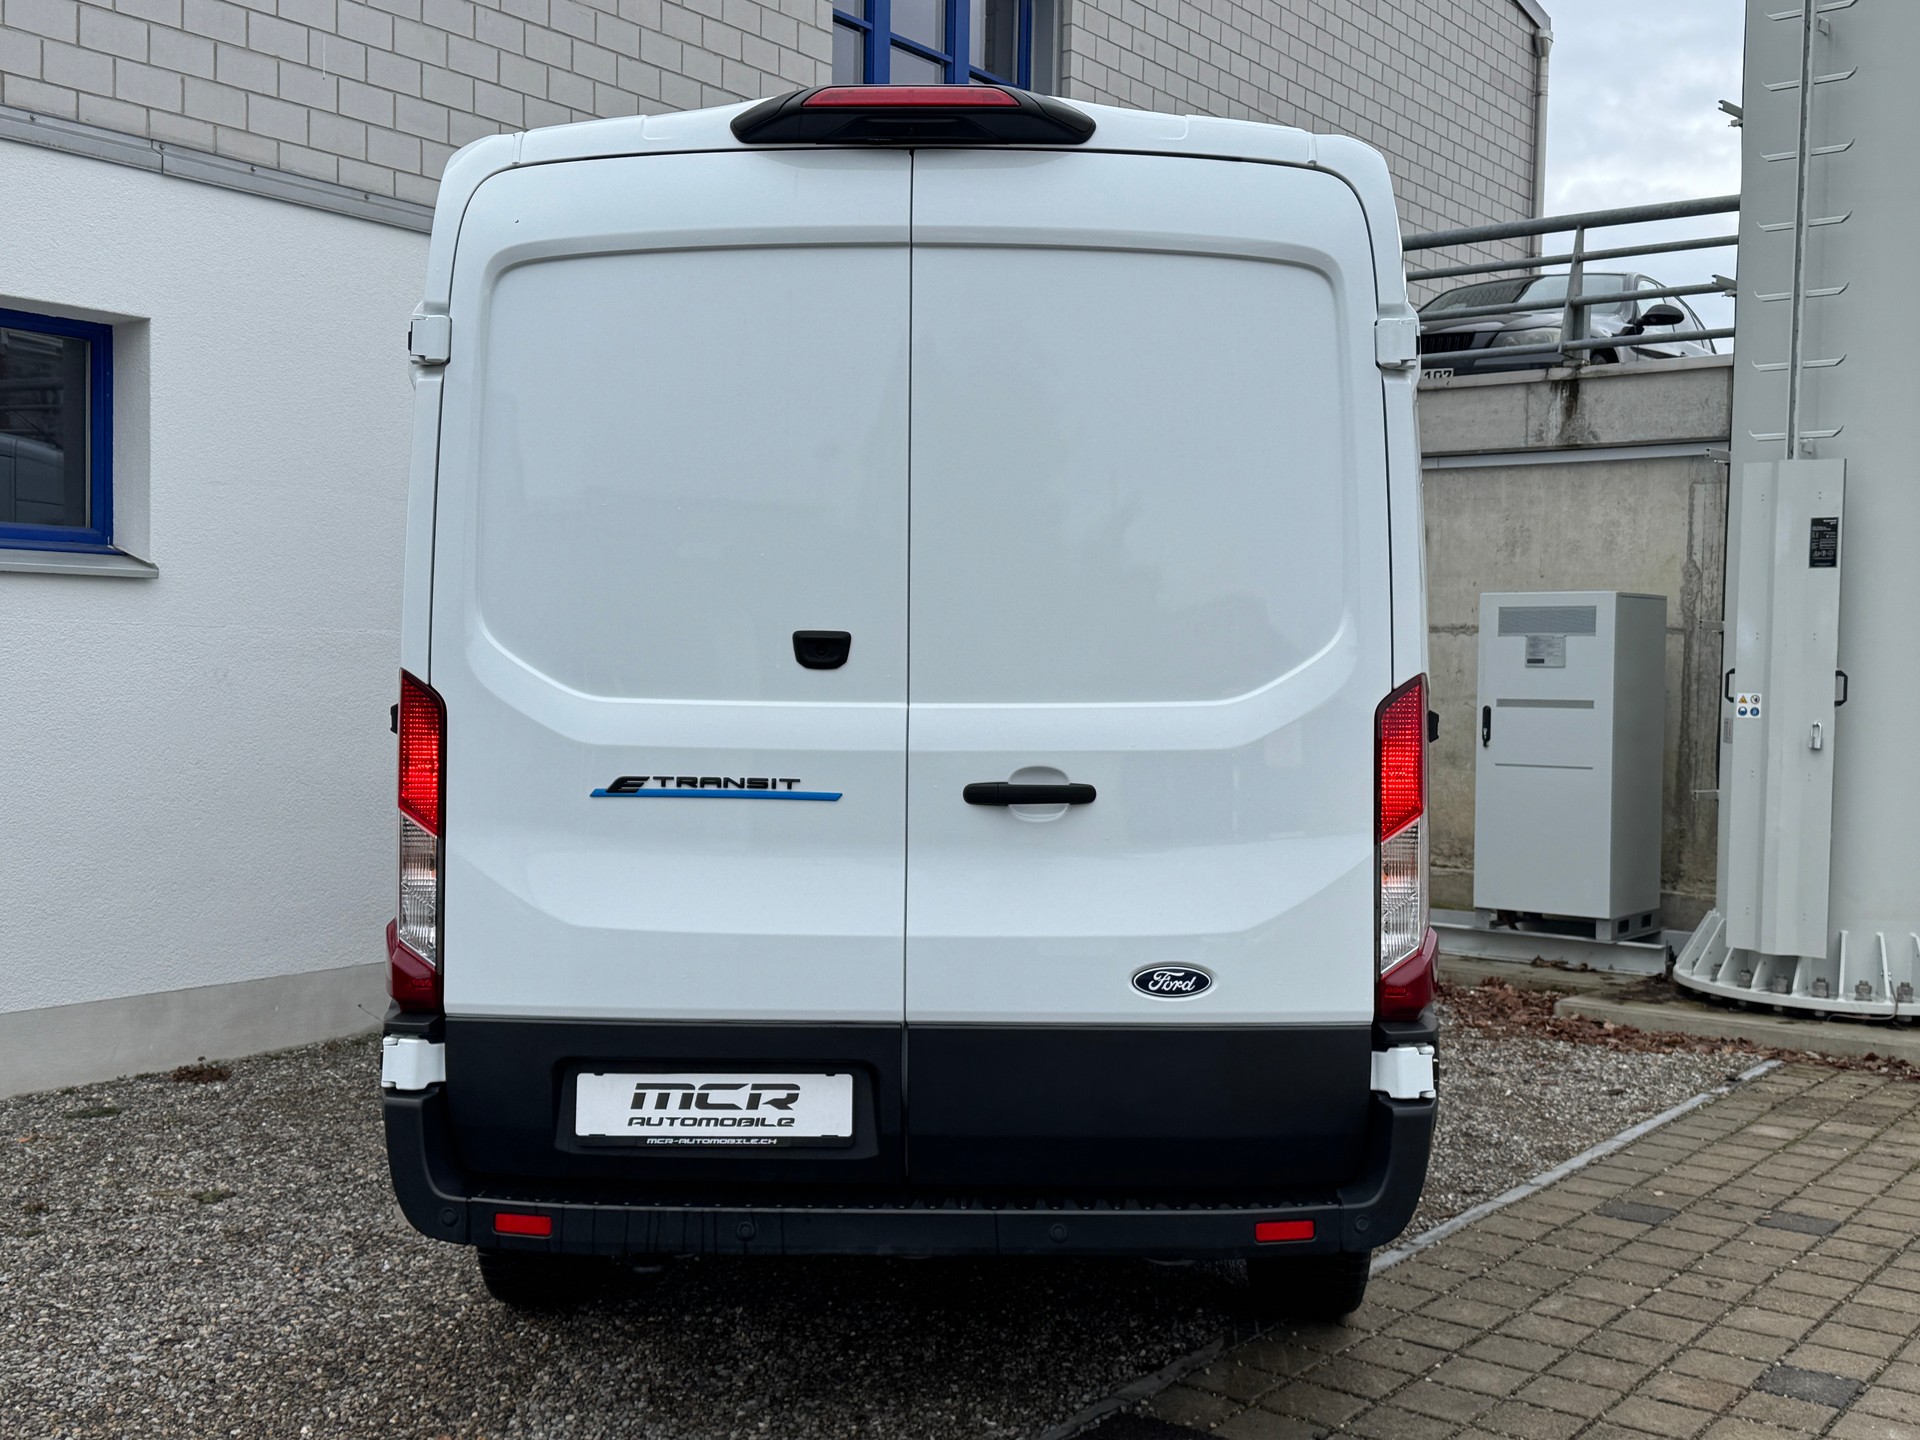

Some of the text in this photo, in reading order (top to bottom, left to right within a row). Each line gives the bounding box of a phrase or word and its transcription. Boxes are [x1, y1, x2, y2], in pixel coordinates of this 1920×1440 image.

[1148, 970, 1197, 991] Ford
[630, 1082, 801, 1111] MCR
[627, 1116, 796, 1128] AUTOMOBILE
